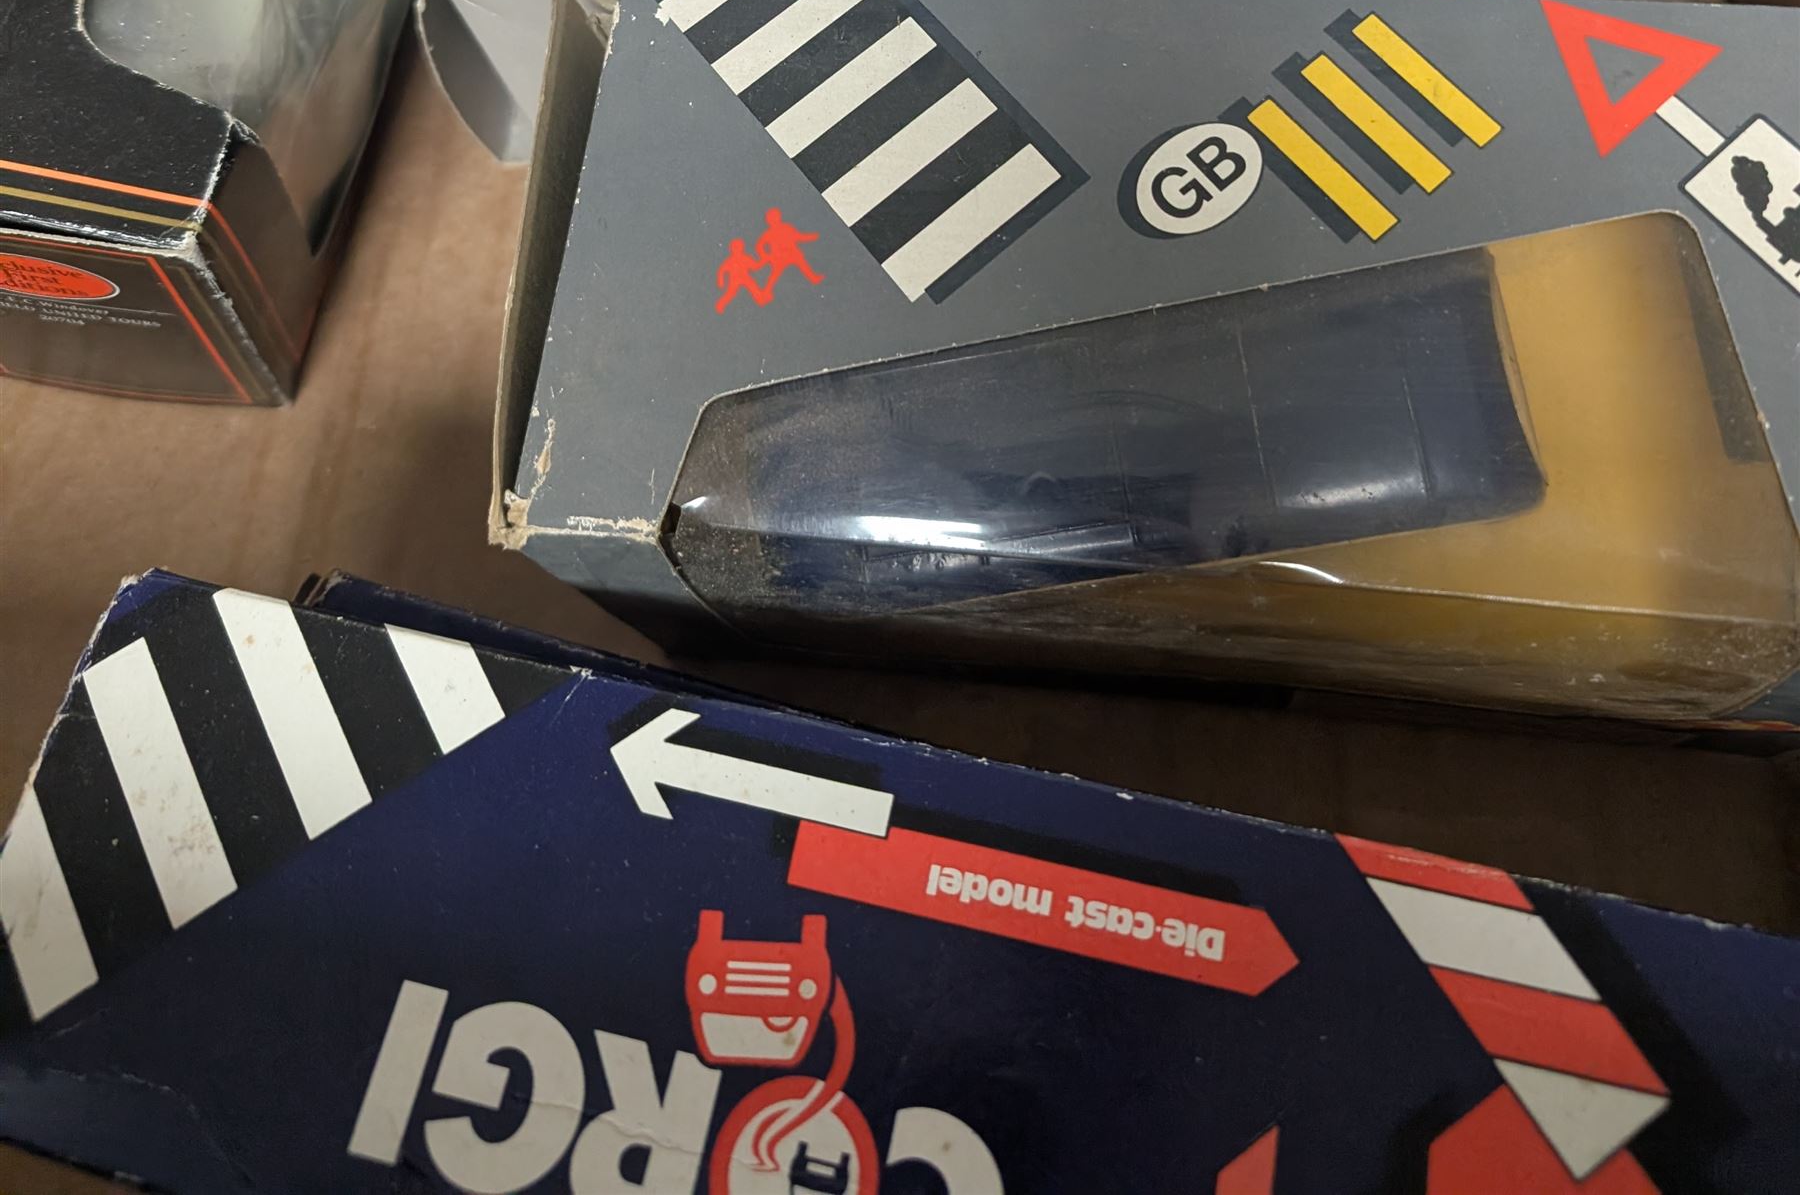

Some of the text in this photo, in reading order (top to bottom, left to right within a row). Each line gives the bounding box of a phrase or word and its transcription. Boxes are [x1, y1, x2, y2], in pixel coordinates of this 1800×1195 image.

[1150, 135, 1247, 219] GB
[3, 266, 64, 285] First
[927, 862, 1052, 918] model
